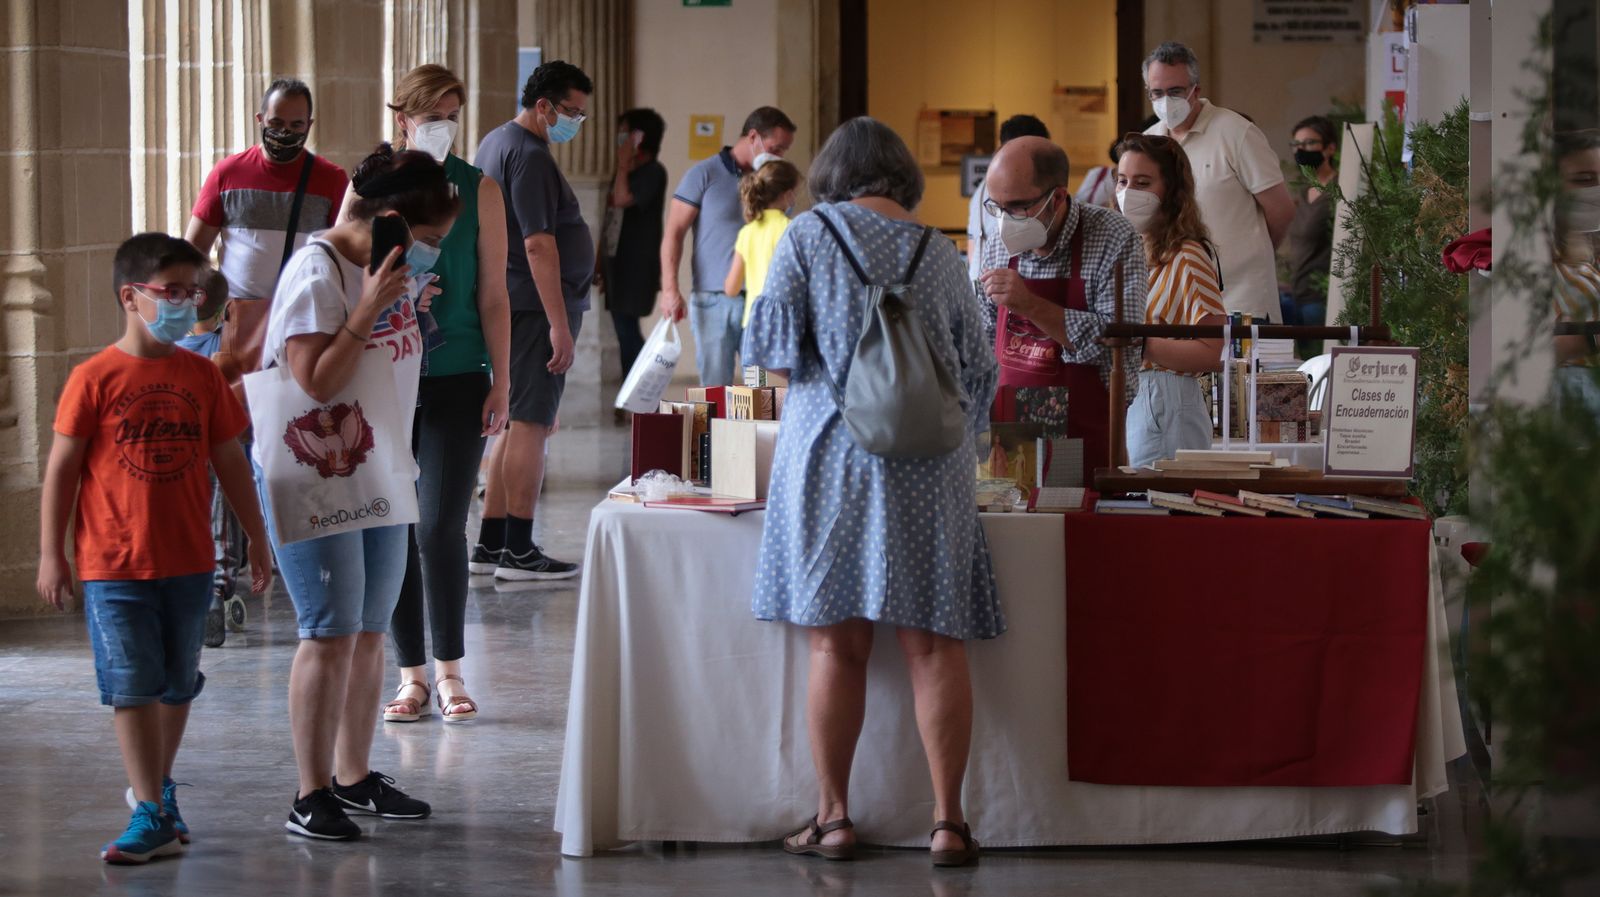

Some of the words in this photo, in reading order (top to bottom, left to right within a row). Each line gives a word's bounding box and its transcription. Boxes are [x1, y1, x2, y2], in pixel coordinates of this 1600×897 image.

[1352, 388, 1382, 402] Clases
[1384, 389, 1396, 402] de
[1335, 404, 1410, 419] Encuadernación
[114, 416, 202, 445] California
